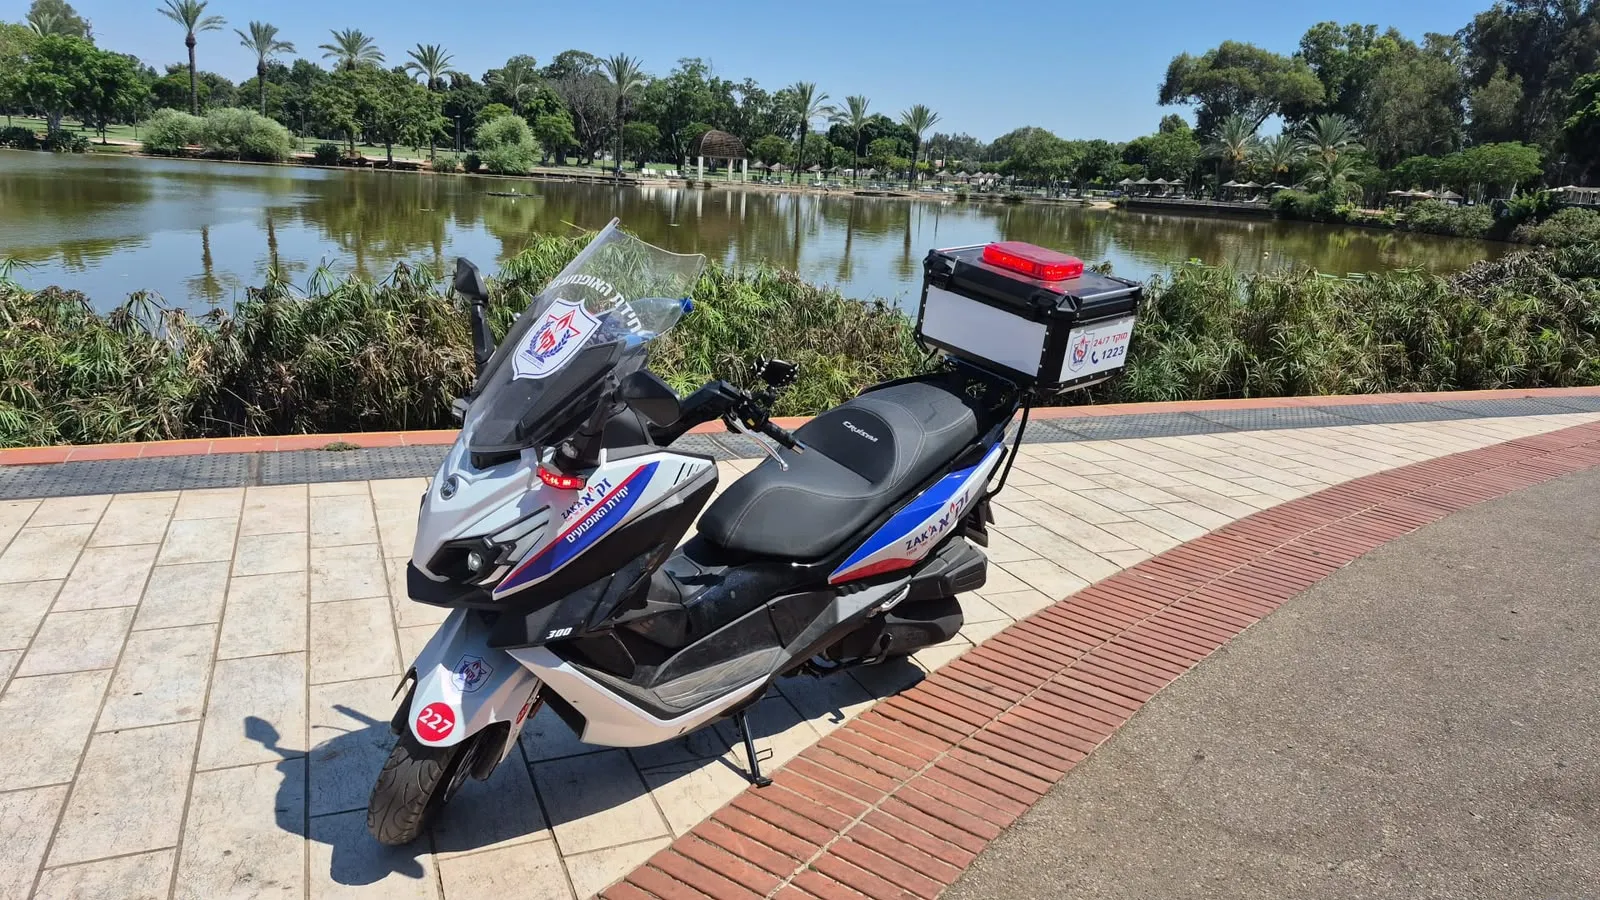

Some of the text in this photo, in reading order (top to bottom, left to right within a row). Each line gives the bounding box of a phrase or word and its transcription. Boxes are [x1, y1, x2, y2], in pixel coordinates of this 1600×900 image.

[1093, 336, 1111, 347] 24/7
[1102, 345, 1125, 360] 1223
[605, 485, 630, 510] יחידת
[566, 506, 609, 543] האופנועים
[545, 627, 573, 640] 300
[418, 707, 454, 735] 227
